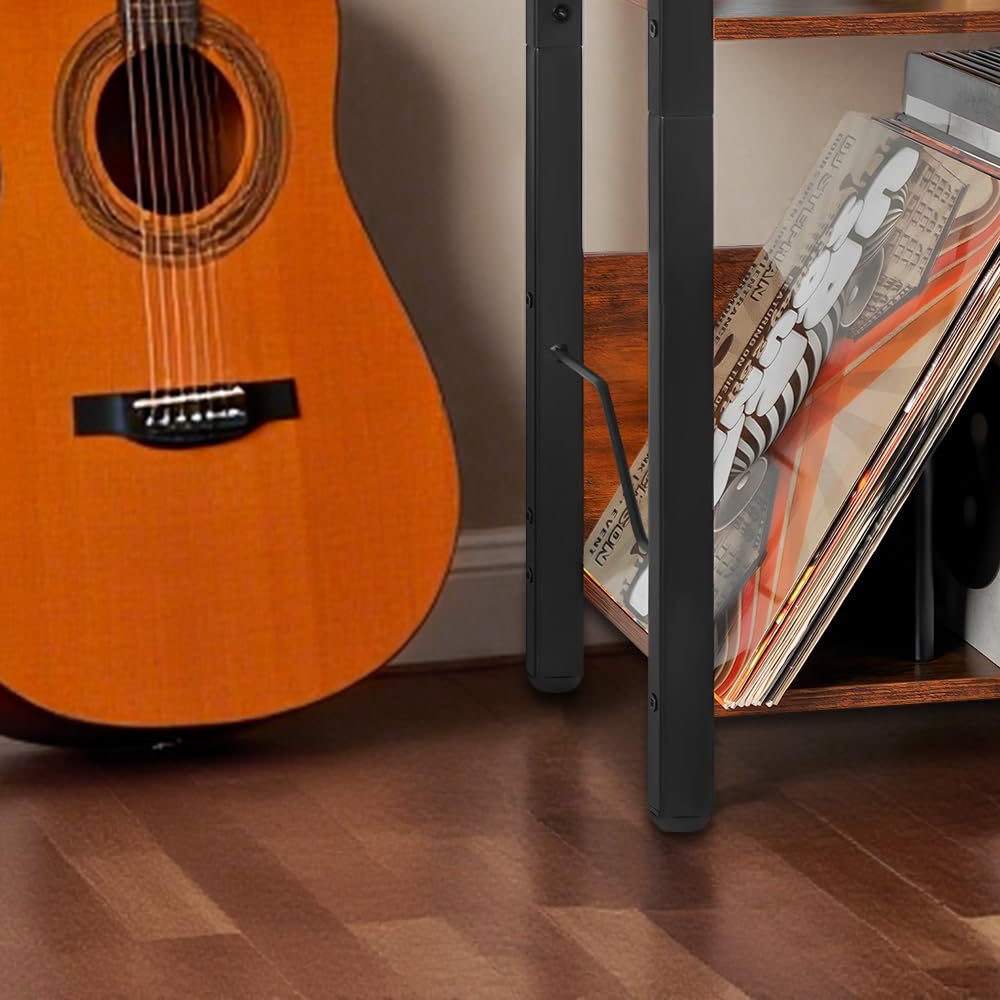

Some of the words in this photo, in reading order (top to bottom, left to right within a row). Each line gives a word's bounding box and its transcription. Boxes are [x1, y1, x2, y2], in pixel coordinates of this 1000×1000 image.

[829, 133, 857, 170] DJ
[749, 170, 834, 303] STEPHAN
[713, 192, 866, 462] SOUN
[747, 273, 794, 348] FEATURING
[720, 369, 738, 394] THE
[735, 347, 750, 367] ON
[587, 507, 618, 557] EVENT
